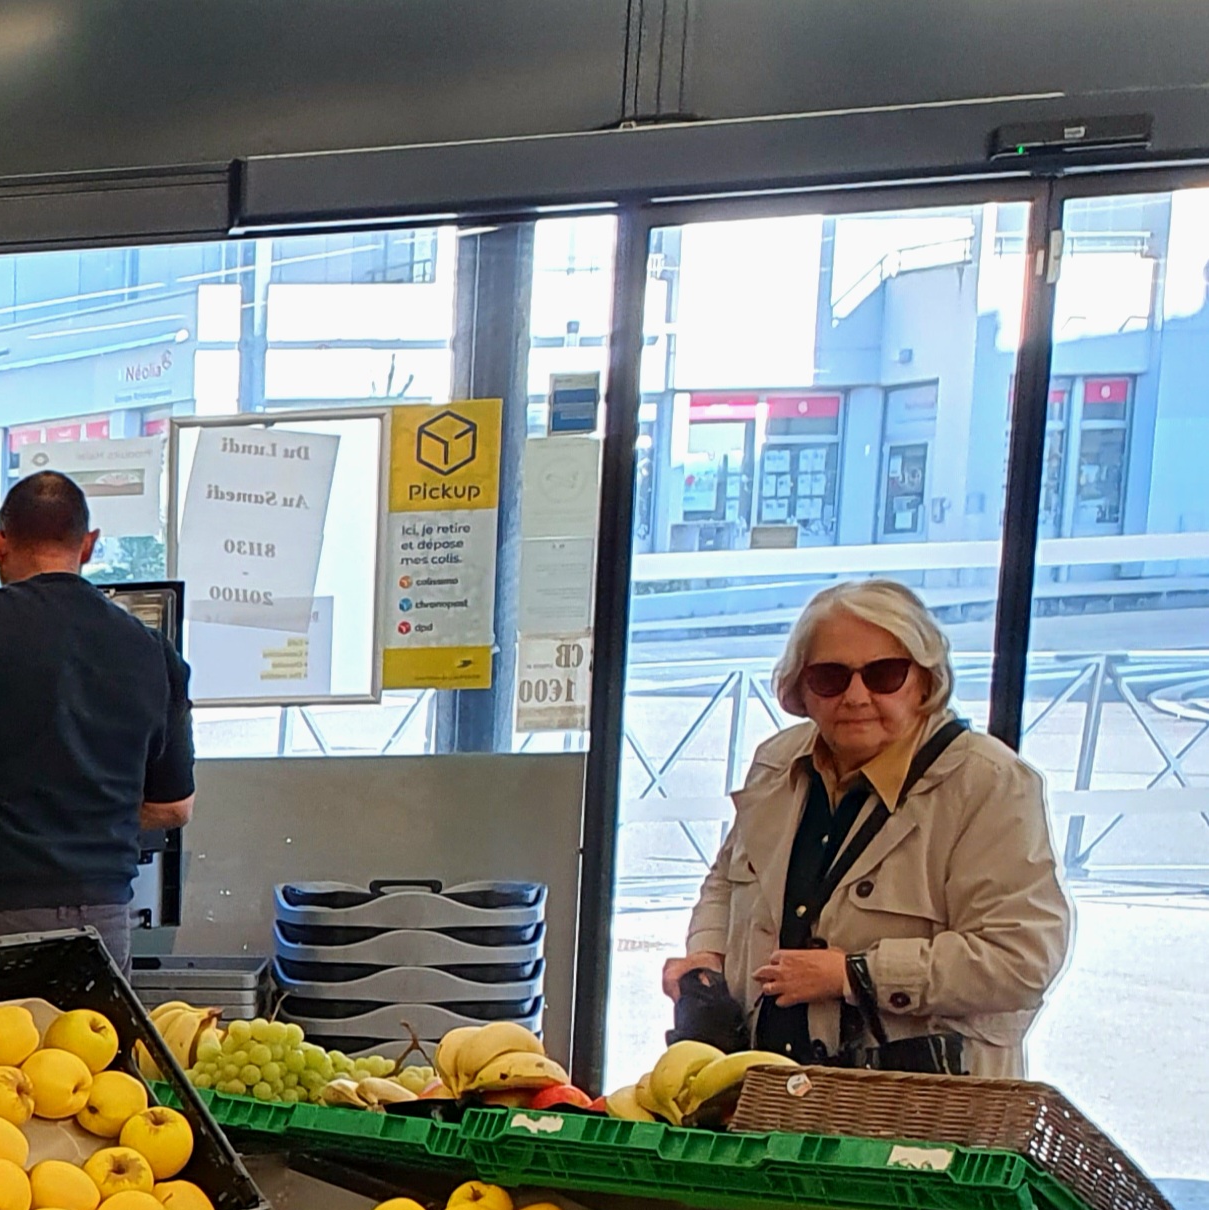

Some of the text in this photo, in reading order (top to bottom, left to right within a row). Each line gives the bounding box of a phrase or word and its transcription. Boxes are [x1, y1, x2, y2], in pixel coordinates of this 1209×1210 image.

[125, 363, 162, 383] Néolia
[409, 483, 480, 501] Pickup
[402, 522, 471, 538] Ici, je retire
[401, 537, 464, 552] et dépose
[400, 553, 462, 566] mes colis.
[415, 576, 459, 587] colissimo
[415, 598, 468, 610] chronopost
[415, 622, 433, 633] dpd
